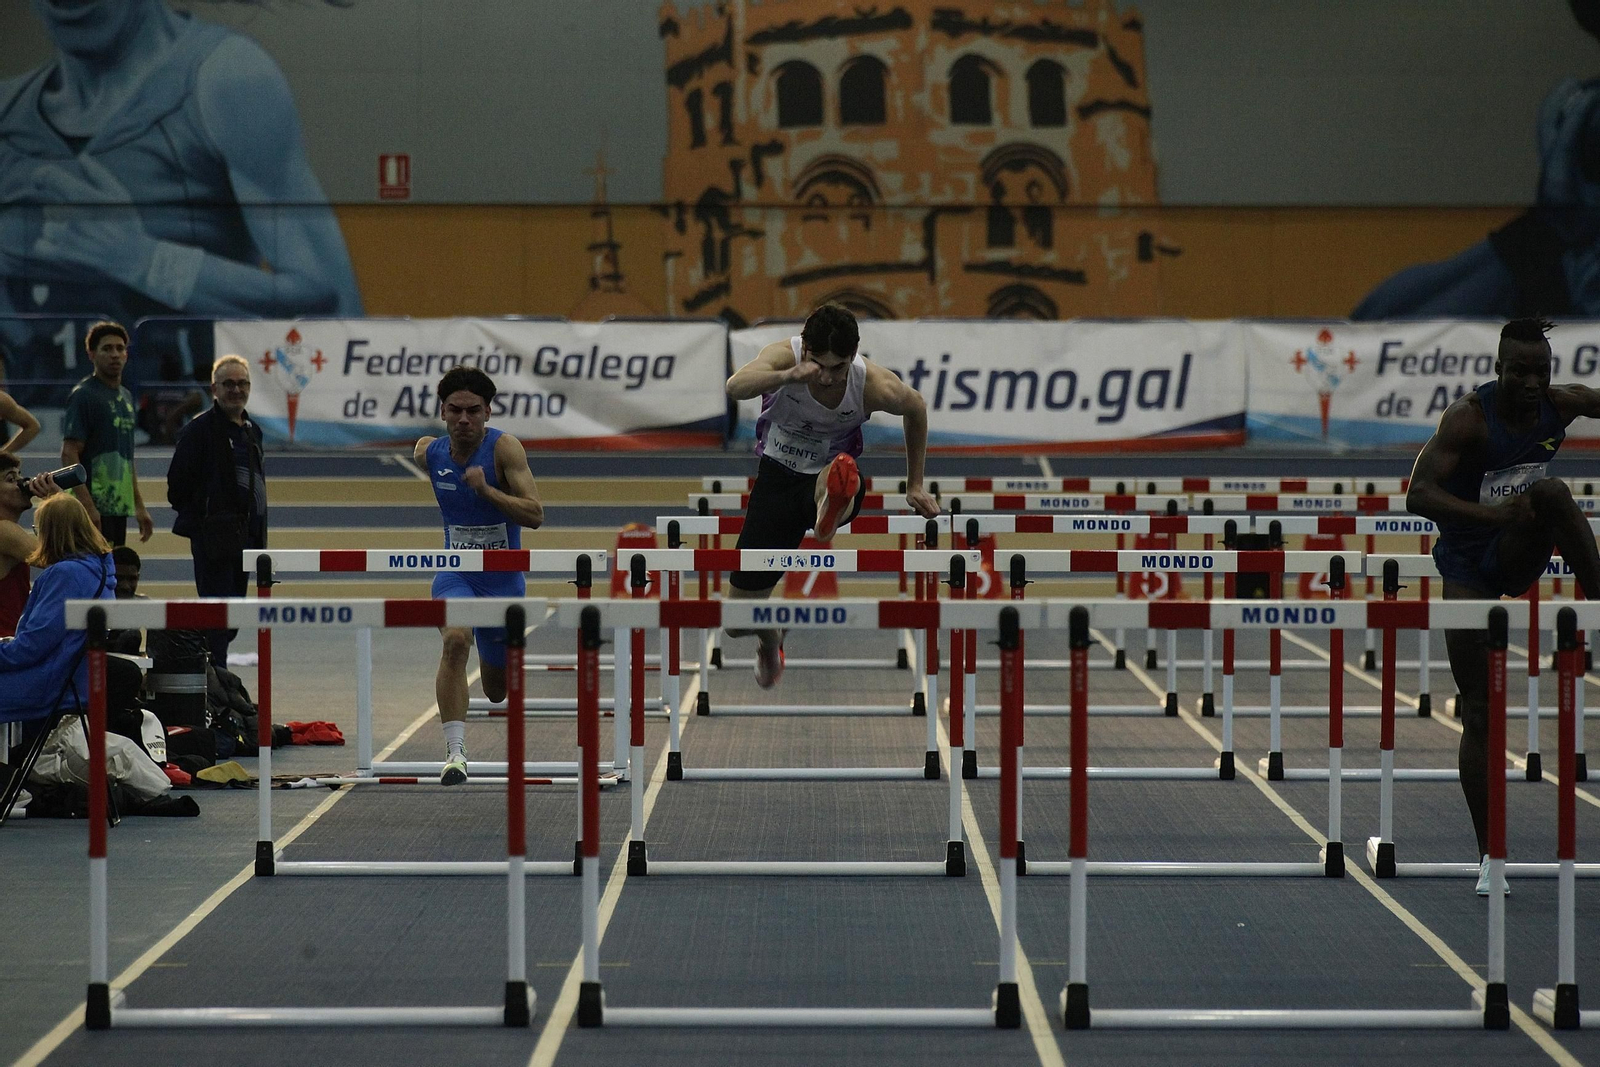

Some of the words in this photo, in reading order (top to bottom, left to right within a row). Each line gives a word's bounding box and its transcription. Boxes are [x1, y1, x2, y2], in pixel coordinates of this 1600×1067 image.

[344, 340, 522, 375] Federación
[533, 345, 675, 389] Galega
[1376, 341, 1560, 376] Federan
[891, 354, 1192, 423] tismo.gal
[343, 393, 378, 417] de
[390, 385, 567, 418] Atlsmo
[1376, 392, 1412, 417] de
[773, 438, 819, 462] VICENTE
[784, 459, 798, 469] 116
[1040, 499, 1090, 509] MONDO
[1293, 499, 1342, 509] MONDO
[1072, 519, 1132, 531] MONDO
[1375, 521, 1434, 532] MONDO
[389, 555, 462, 568] MONDO
[1141, 555, 1214, 569] MONDO
[258, 606, 352, 623] MONDO
[753, 607, 847, 623] MONDO
[1241, 607, 1336, 624] MONDO
